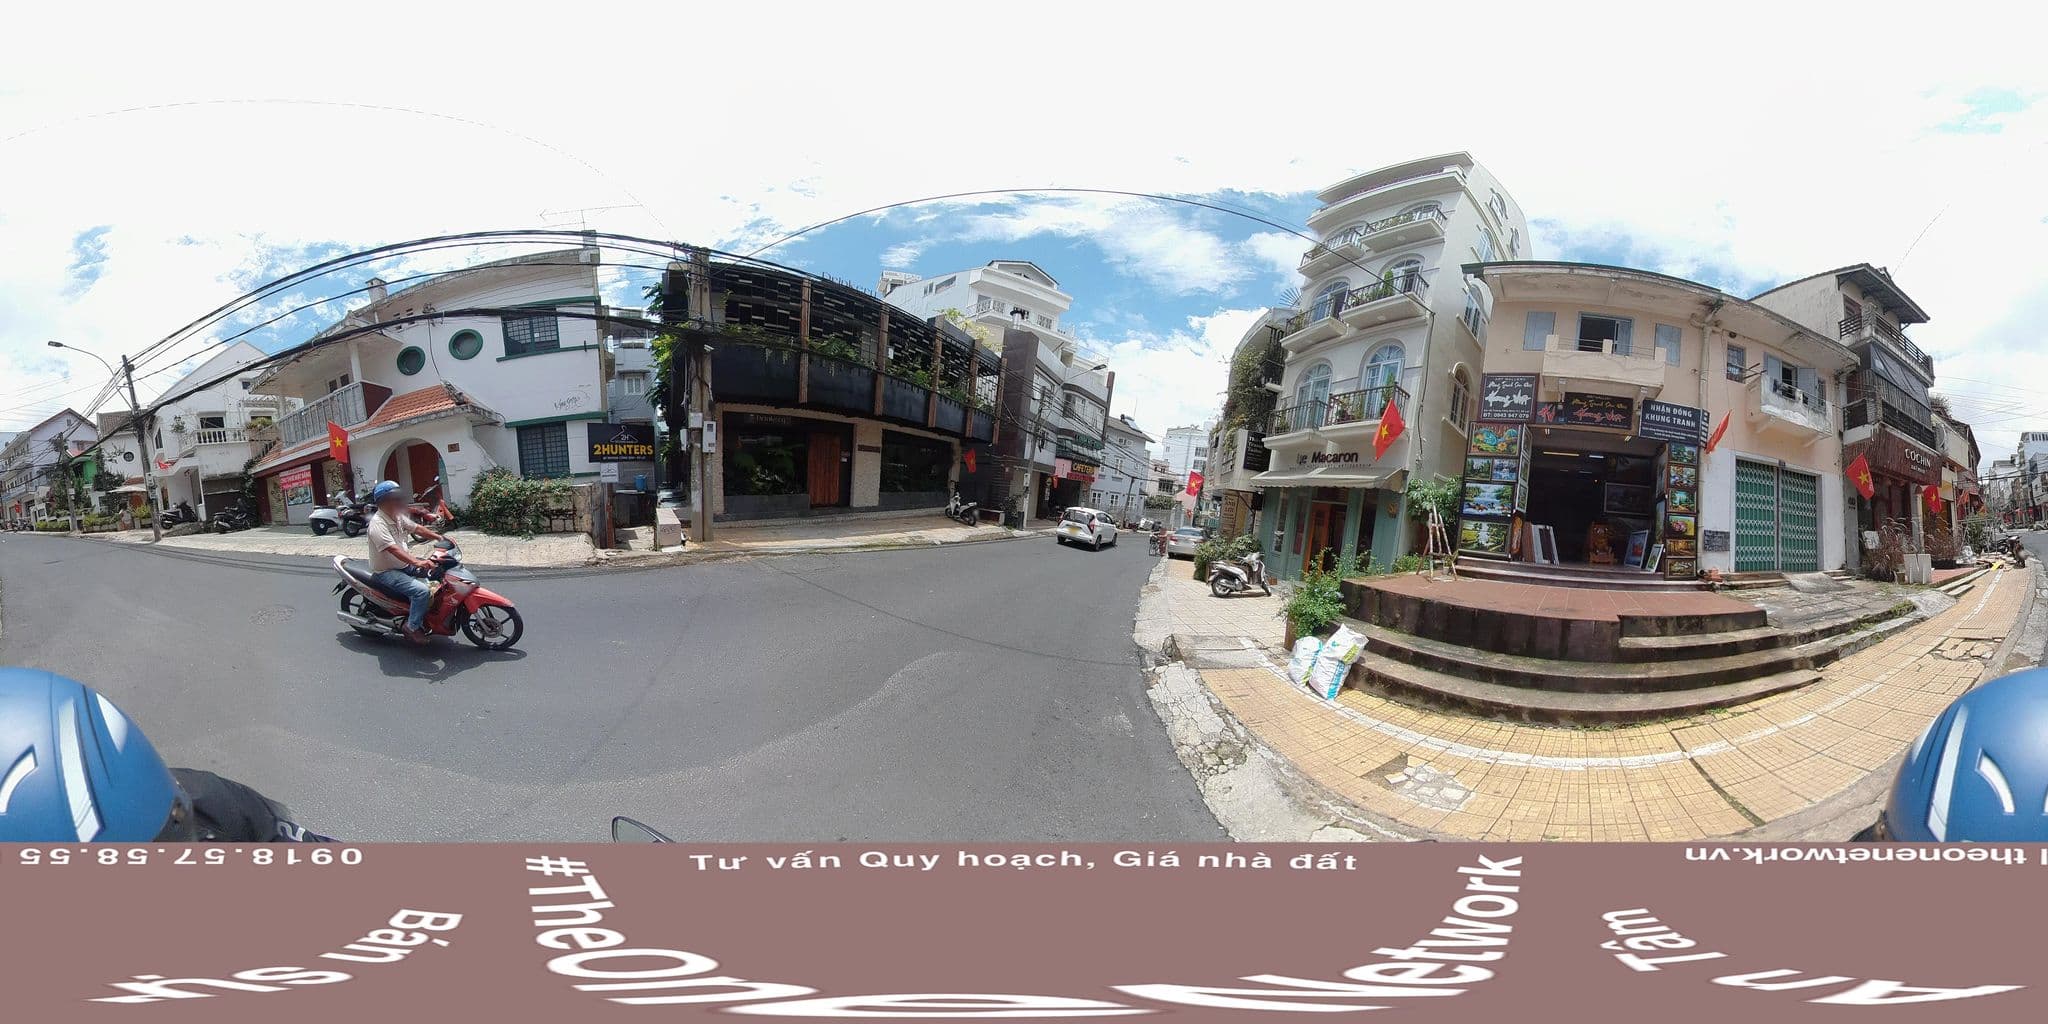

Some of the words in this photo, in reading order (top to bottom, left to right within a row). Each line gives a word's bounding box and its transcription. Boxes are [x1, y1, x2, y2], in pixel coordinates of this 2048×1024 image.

[1650, 404, 1671, 415] NHẬN
[1672, 407, 1693, 418] ĐÓNG
[1645, 413, 1671, 424] KHUNG
[1672, 417, 1696, 428] TRANH
[593, 444, 654, 456] 2HUNTERS
[1311, 452, 1359, 464] Macaron
[1905, 448, 1931, 468] COCHIN
